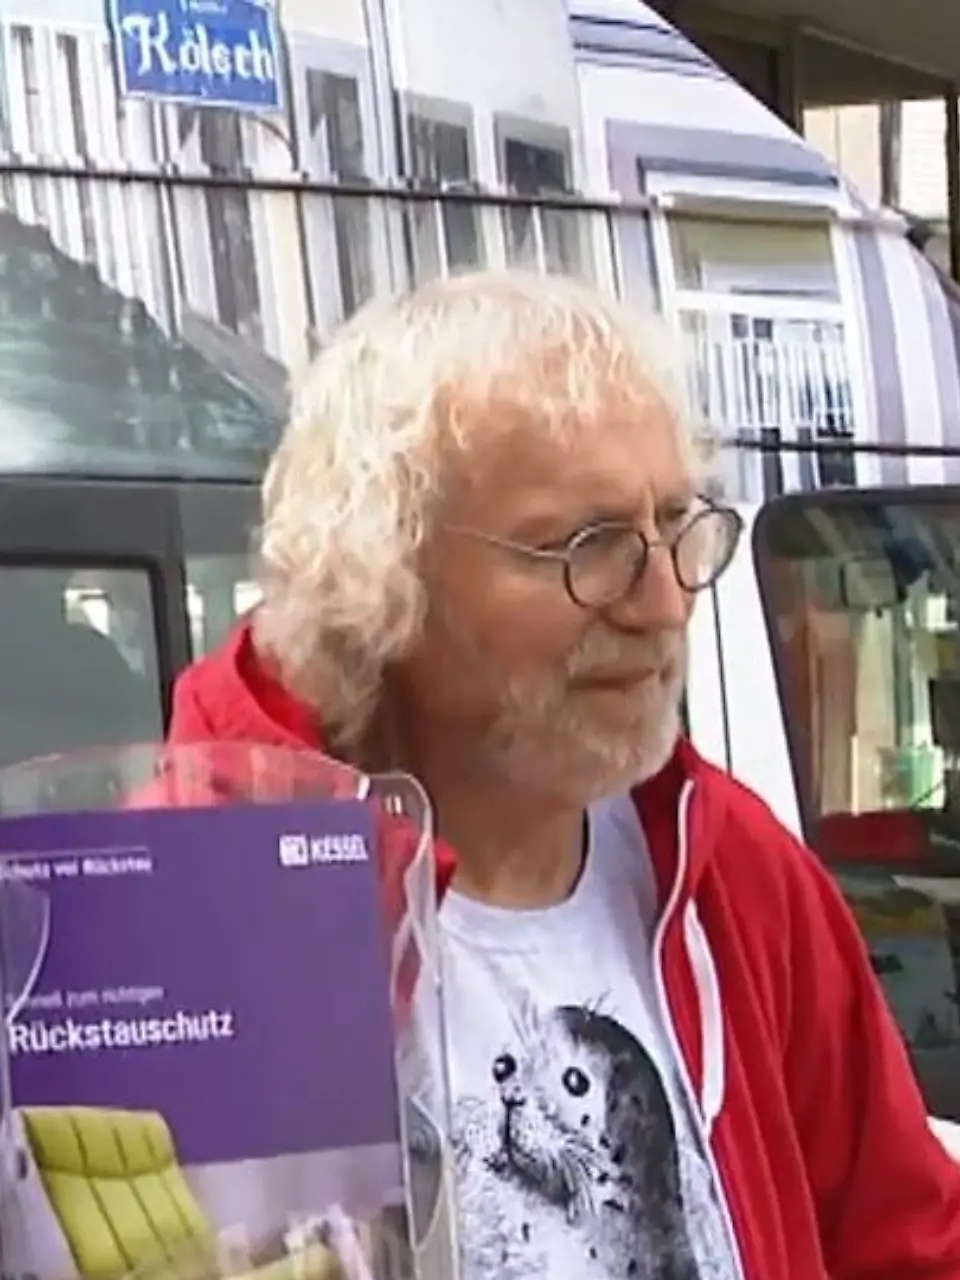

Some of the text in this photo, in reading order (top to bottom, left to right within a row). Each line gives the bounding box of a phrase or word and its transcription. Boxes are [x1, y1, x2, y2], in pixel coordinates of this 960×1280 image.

[122, 11, 274, 84] Kölsch
[311, 833, 369, 862] KESSEL
[8, 1009, 235, 1055] Rückstauschutz
